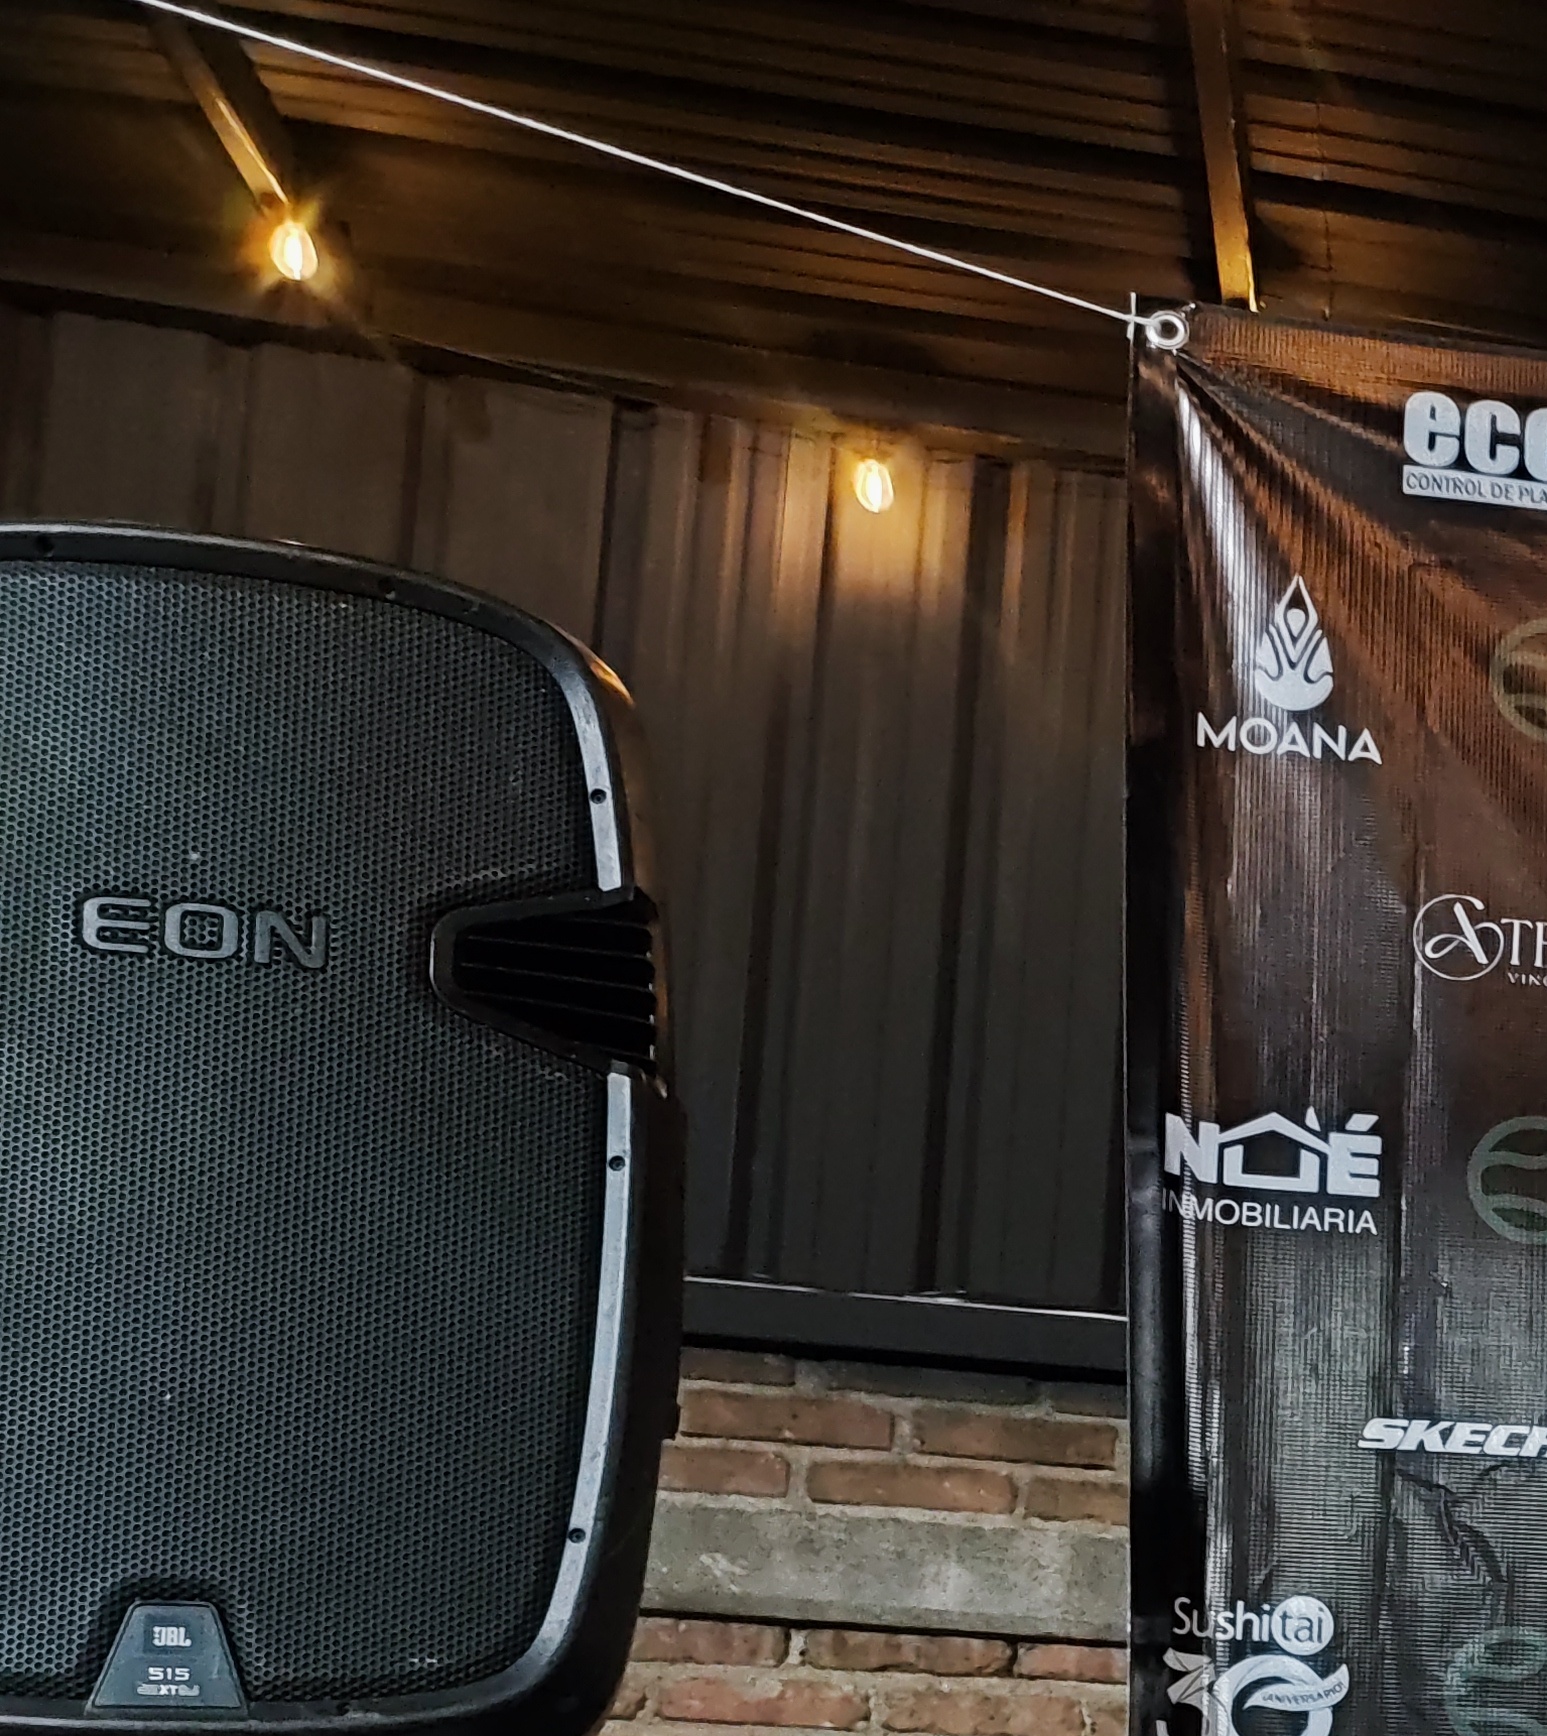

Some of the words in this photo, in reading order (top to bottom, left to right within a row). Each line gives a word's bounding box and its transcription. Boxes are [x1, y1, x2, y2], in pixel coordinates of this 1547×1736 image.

[1406, 472, 1483, 497] CONTROL
[1490, 483, 1514, 500] DE
[1197, 712, 1383, 766] MOANA
[81, 895, 327, 970] EON
[1162, 1187, 1378, 1236] INMOBILIARIA
[152, 1625, 192, 1647] JBL
[148, 1666, 191, 1681] 515
